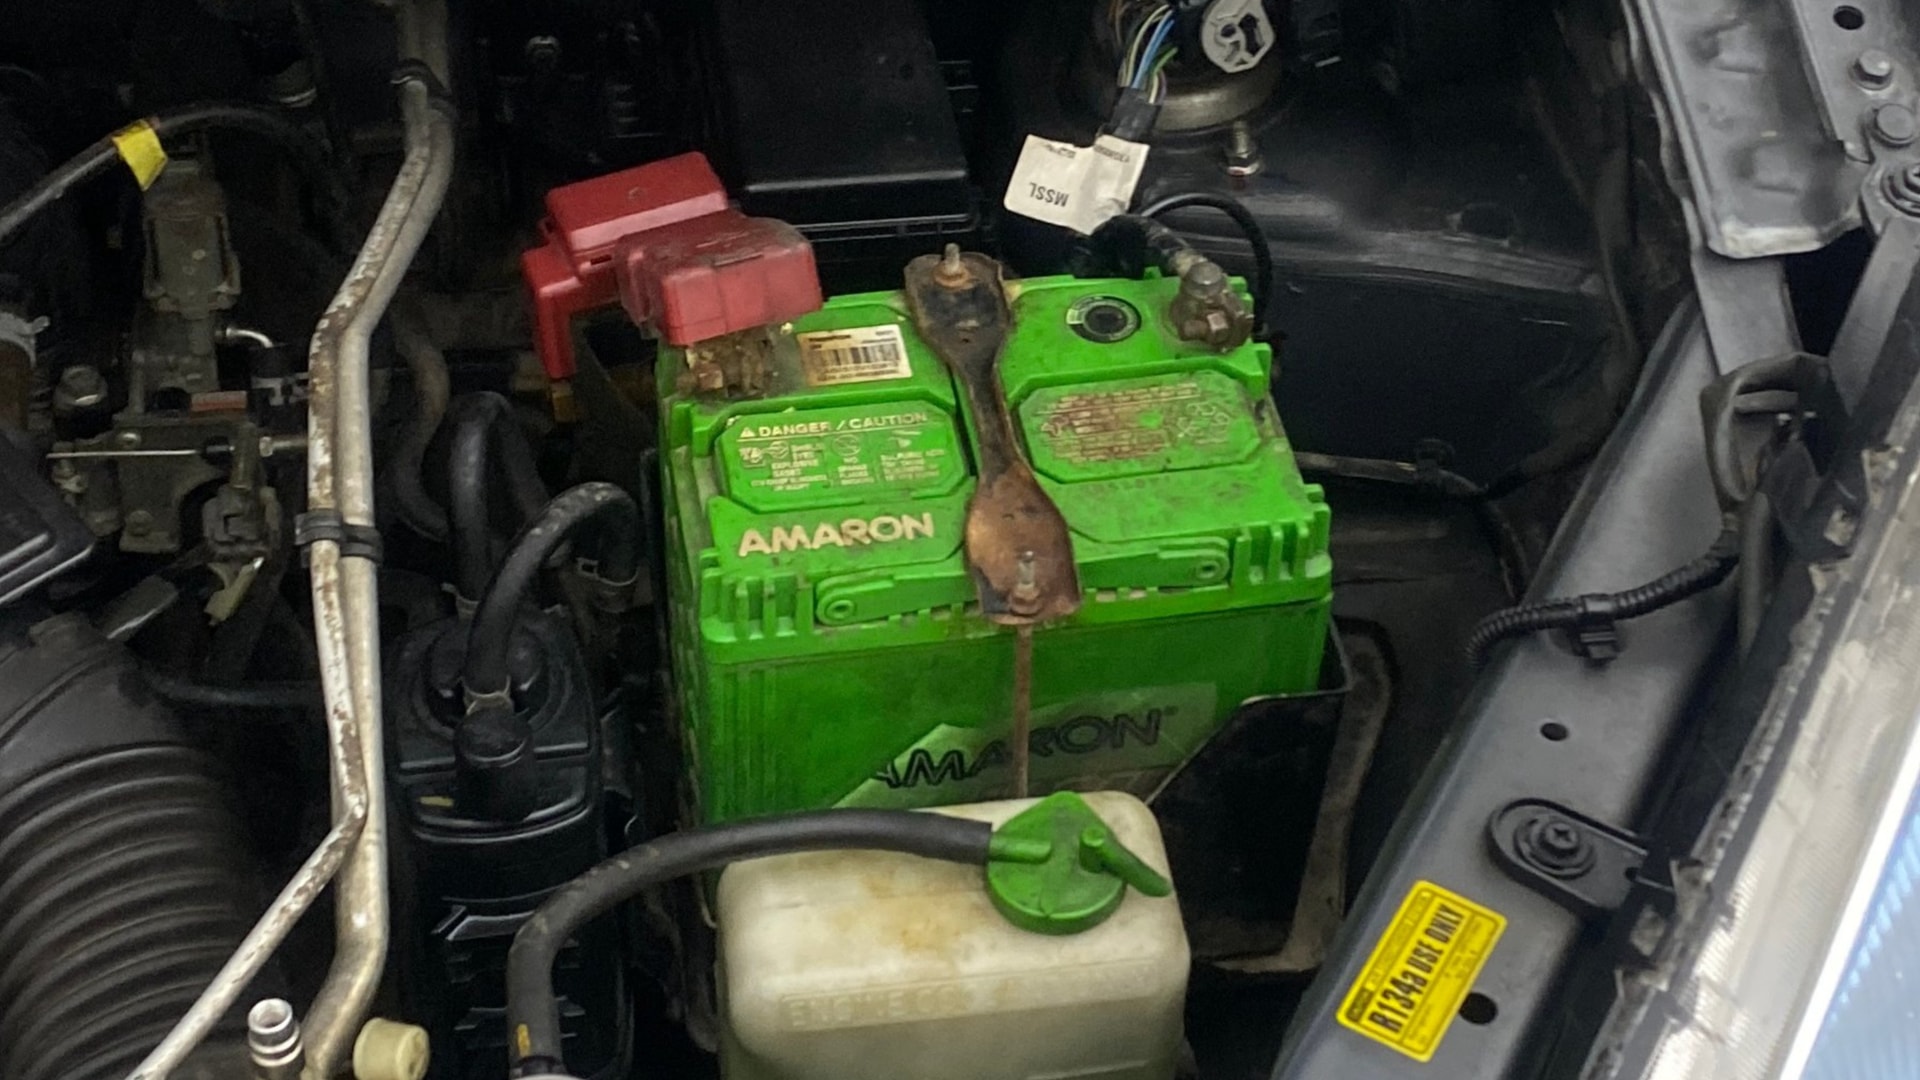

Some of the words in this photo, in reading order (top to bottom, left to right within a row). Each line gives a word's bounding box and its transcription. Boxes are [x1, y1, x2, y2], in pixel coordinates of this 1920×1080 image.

[1028, 181, 1070, 208] MSSL
[758, 421, 830, 438] DANGER
[848, 412, 928, 430] CAUTION
[738, 511, 935, 558] AMARON
[1424, 903, 1465, 945] ONLY
[1405, 940, 1444, 974] USE
[1367, 969, 1429, 1034] R134a
